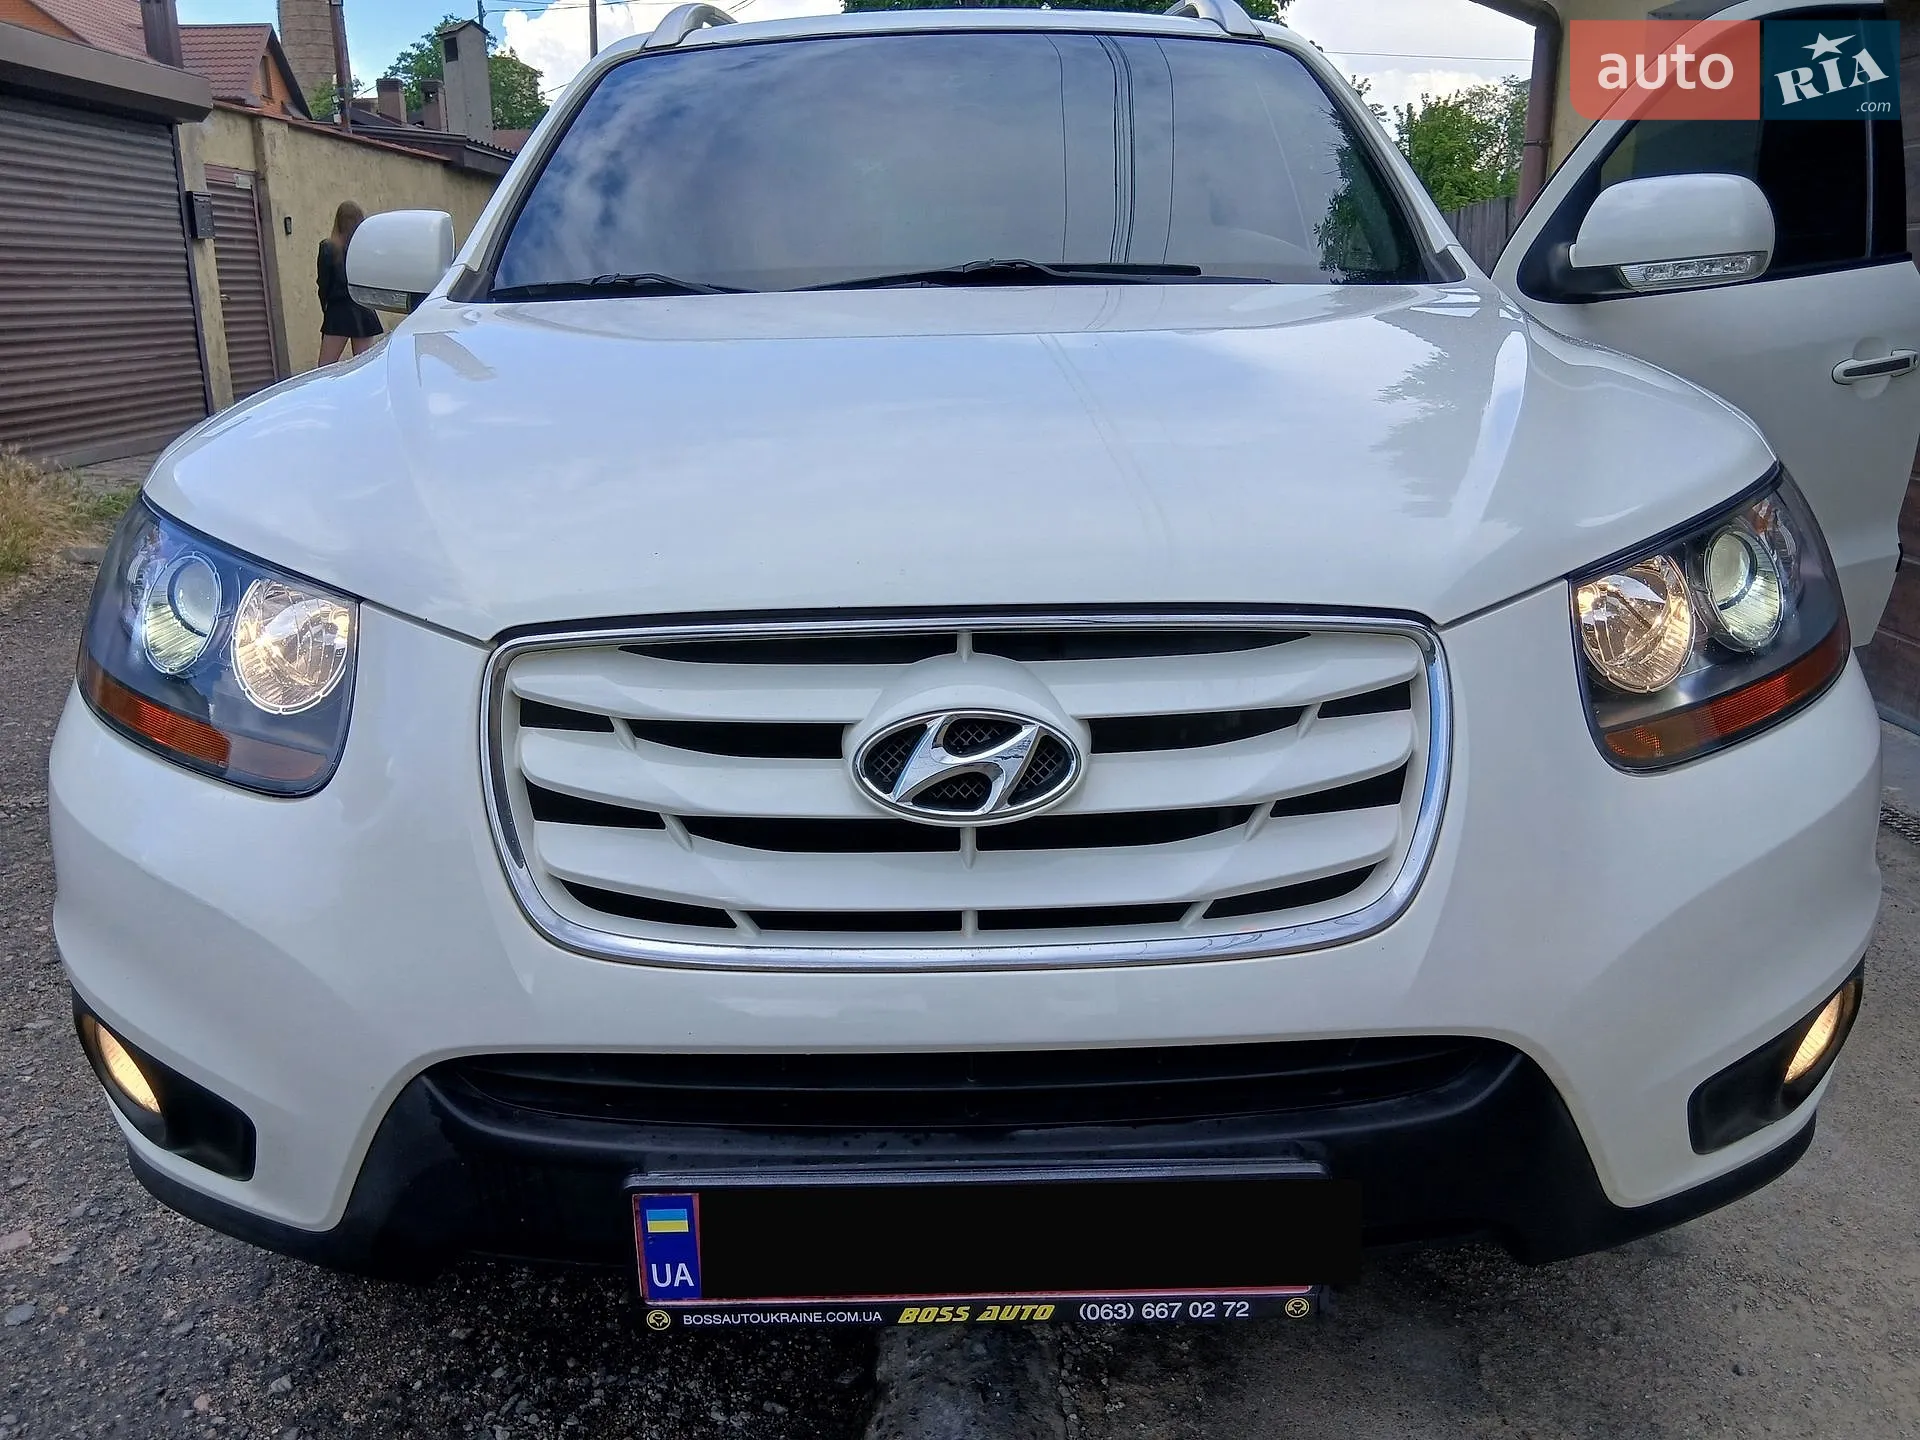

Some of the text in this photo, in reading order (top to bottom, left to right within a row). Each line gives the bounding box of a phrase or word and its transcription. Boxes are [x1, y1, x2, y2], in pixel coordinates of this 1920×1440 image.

[651, 1263, 695, 1287] UA
[683, 1301, 1249, 1325] BOSSAUTOUKRAINE.COM.UA BOSS AUTO (063) 667 02 72
